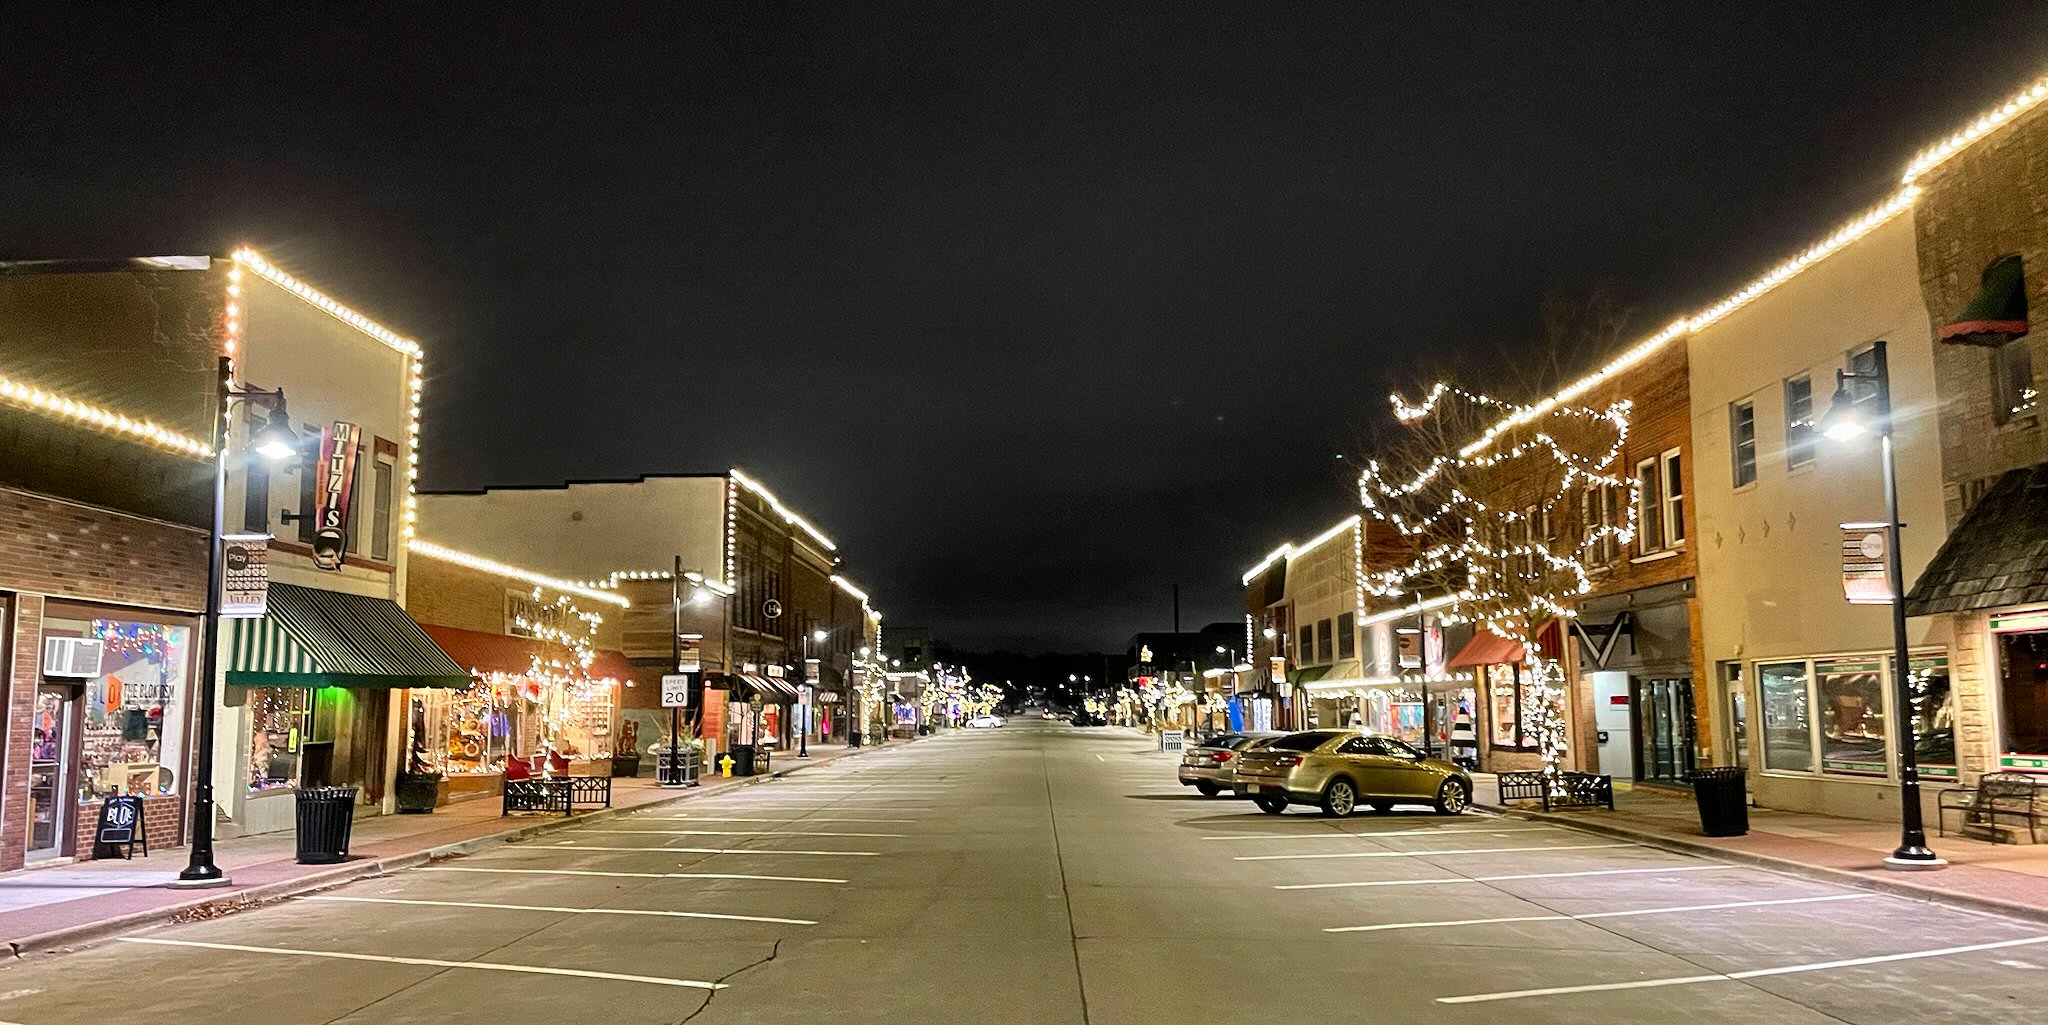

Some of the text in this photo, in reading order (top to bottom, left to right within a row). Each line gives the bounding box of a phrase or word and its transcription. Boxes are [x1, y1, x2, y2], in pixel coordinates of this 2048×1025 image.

[229, 553, 247, 563] Play
[665, 692, 685, 703] 20
[107, 806, 133, 825] BLOK
